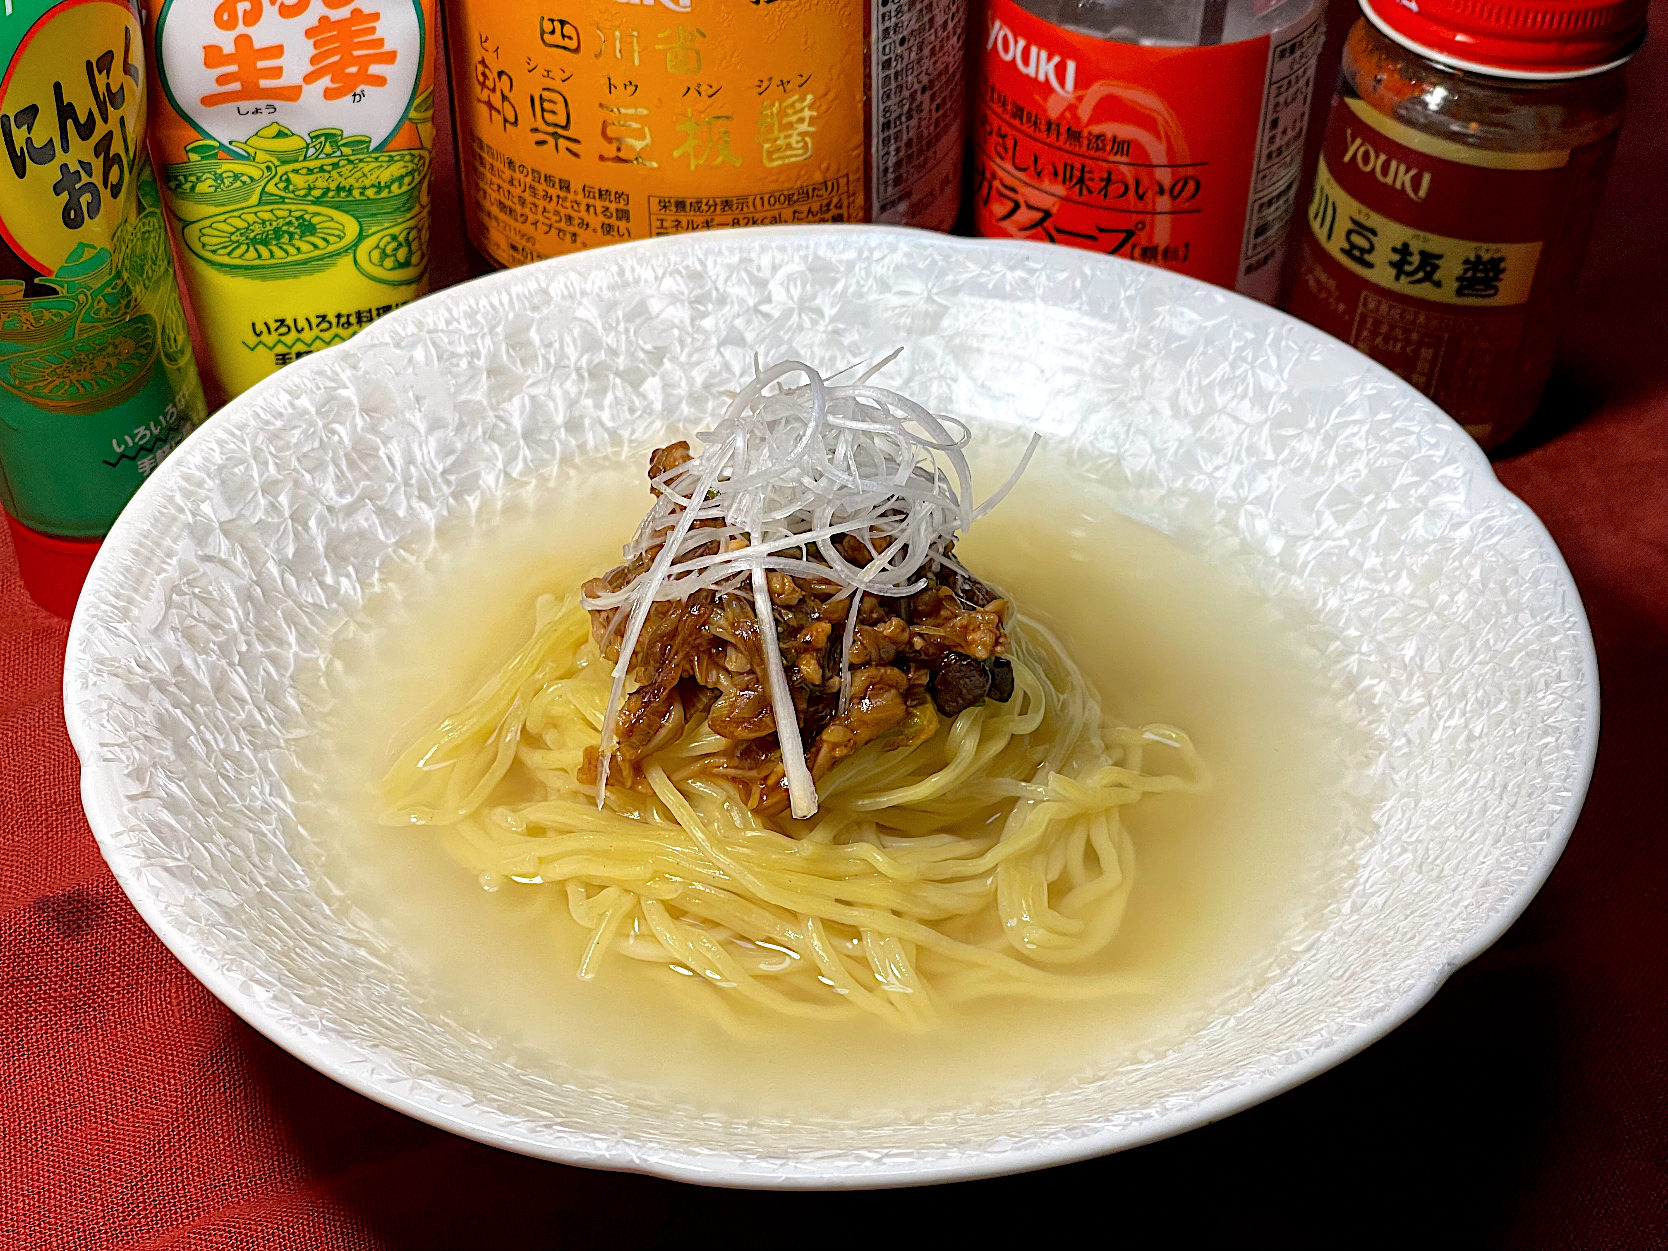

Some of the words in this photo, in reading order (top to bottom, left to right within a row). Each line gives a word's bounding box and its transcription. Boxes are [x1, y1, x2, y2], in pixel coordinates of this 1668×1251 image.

[200, 8, 397, 107] 生姜
[539, 16, 706, 74] 四川省
[1, 25, 140, 180] にんにく
[236, 103, 277, 116] しょう
[351, 89, 366, 104] が
[53, 115, 138, 229] おろし
[1343, 127, 1432, 203] YOUKI
